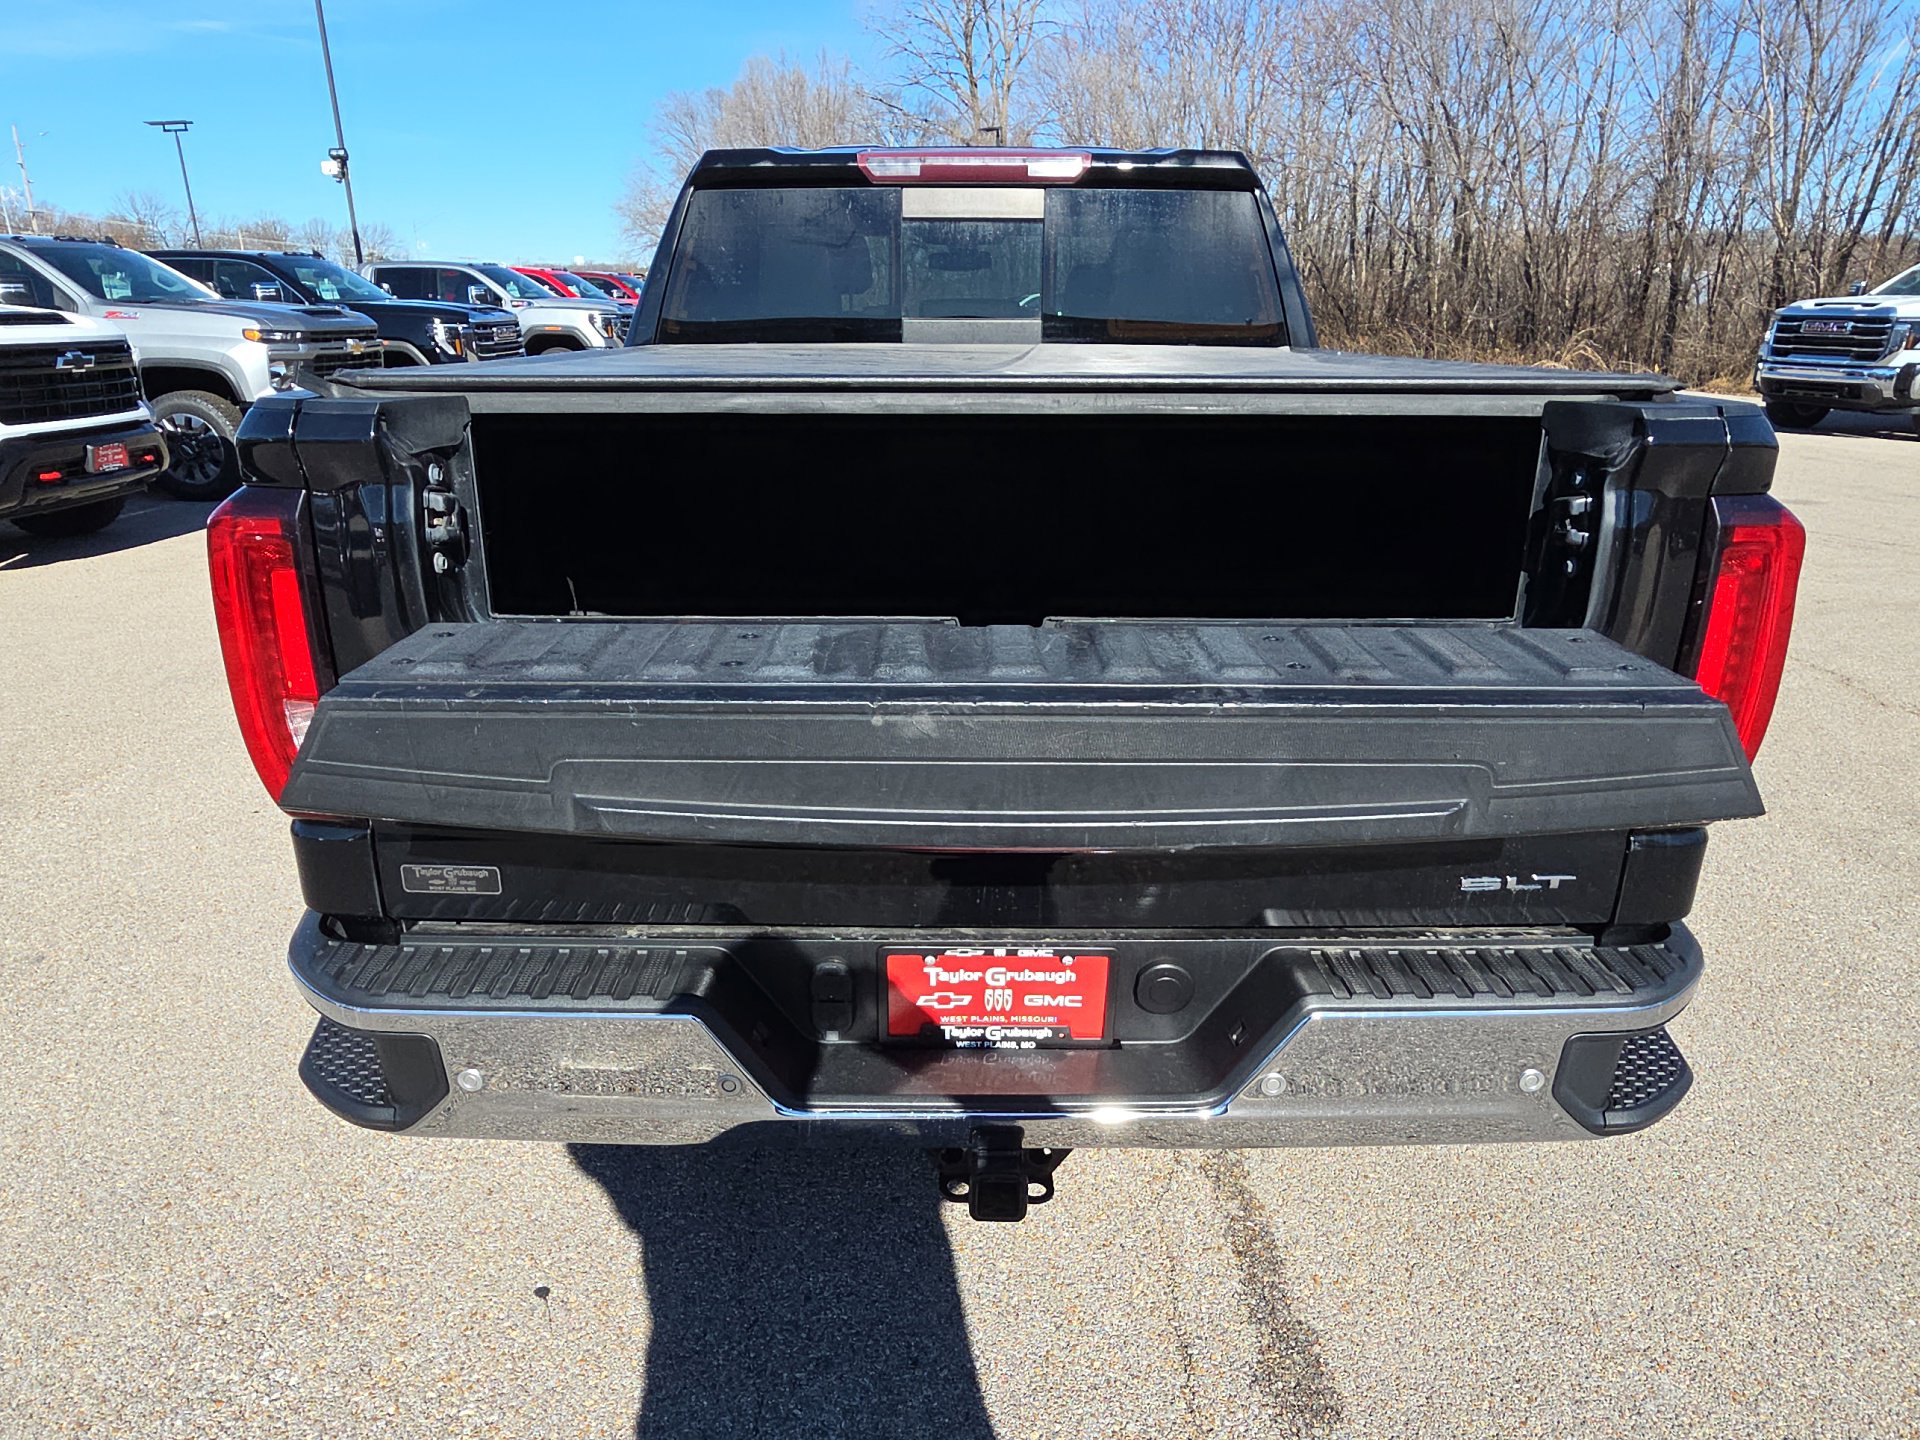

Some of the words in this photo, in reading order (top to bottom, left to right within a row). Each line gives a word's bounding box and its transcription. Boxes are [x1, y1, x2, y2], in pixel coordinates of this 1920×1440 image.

[412, 867, 442, 878] Taylor
[443, 867, 489, 879] Grubaugh
[1460, 874, 1577, 890] SLT
[1017, 949, 1054, 957] GMC
[923, 967, 983, 986] Taylor
[985, 967, 1077, 986] Grubaugh
[1024, 995, 1083, 1007] GMC
[940, 1025, 984, 1040] Taylor
[985, 1025, 1053, 1040] Grubaugh
[984, 1041, 1019, 1049] PLAINS,
[1020, 1041, 1036, 1049] MO
